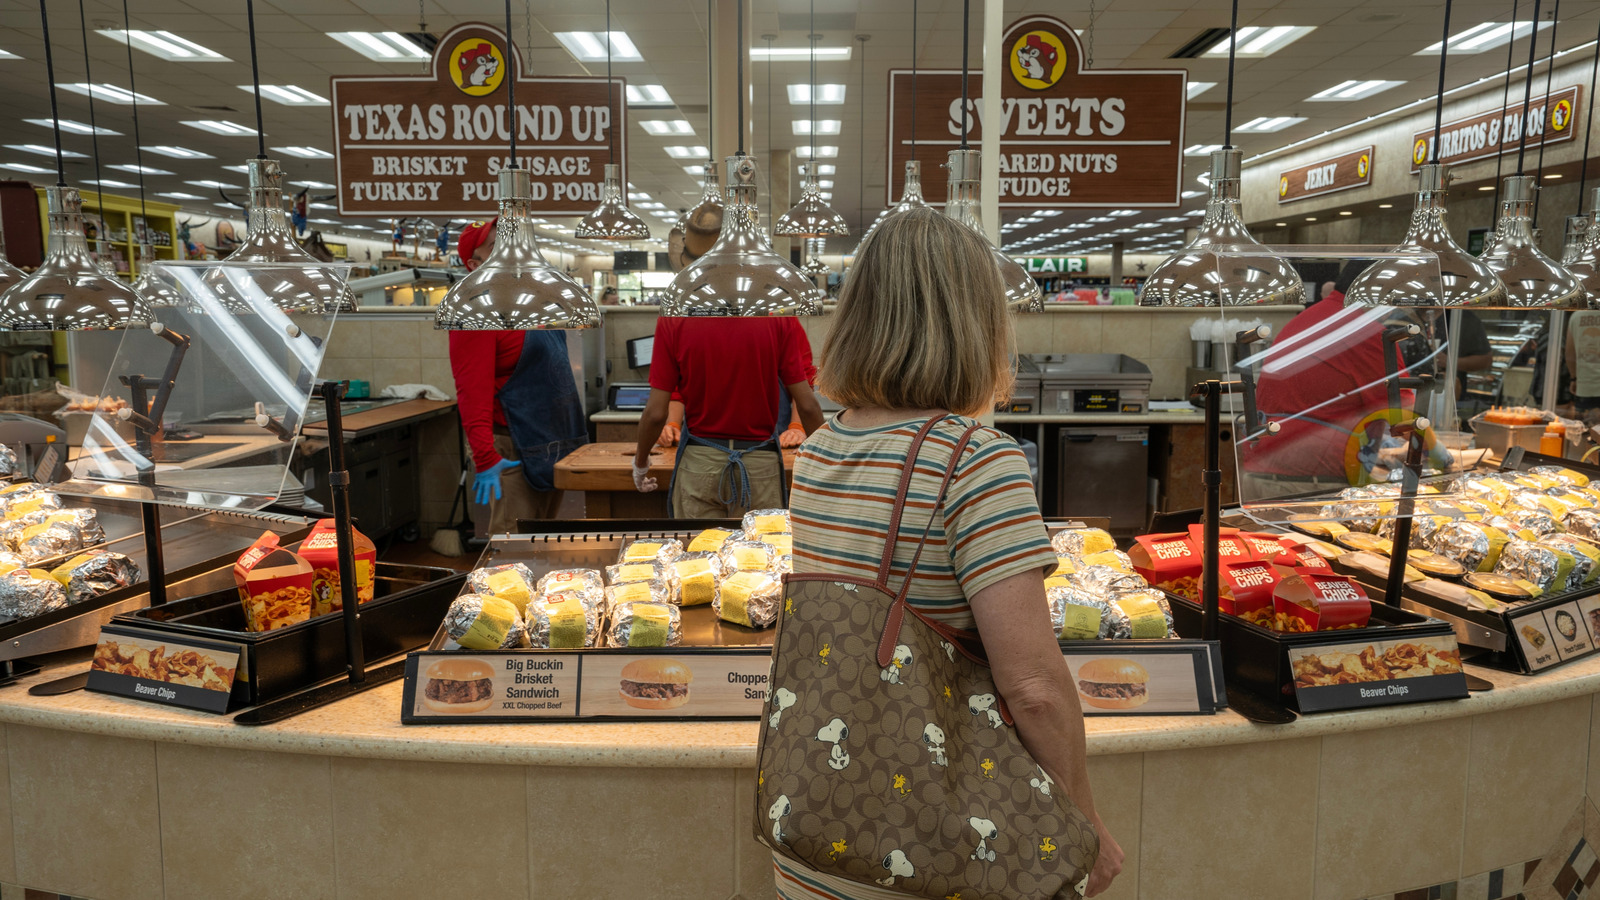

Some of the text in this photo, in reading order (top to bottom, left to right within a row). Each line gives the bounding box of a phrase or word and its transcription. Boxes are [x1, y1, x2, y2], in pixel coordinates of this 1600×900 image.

[344, 104, 611, 142] TEXAS ROUND UP
[1488, 118, 1500, 147] &
[372, 156, 468, 176] BRISKET
[1059, 154, 1117, 173] NUTS
[1304, 163, 1337, 191] JERKY
[350, 182, 442, 201] TURKEY
[999, 177, 1071, 197] FUDGE
[313, 532, 337, 540] BEAVE
[1249, 538, 1279, 546] BEAVER
[1151, 540, 1186, 550] BEAVER
[1156, 546, 1192, 559] CHIPS
[1229, 566, 1266, 578] BEAVER
[1235, 572, 1274, 588] CHIPS
[1314, 581, 1352, 590] BEAVER
[1321, 588, 1360, 601] CHIPS
[506, 659, 563, 672] Big Buckin
[515, 673, 553, 684] Brisket
[728, 672, 767, 685] Choppe
[135, 683, 176, 700] Beaver Chips
[506, 687, 559, 698] Sandwich
[745, 688, 765, 699] San
[1360, 685, 1409, 698] Beaver Chips
[517, 702, 545, 710] Chopped
[547, 702, 562, 710] Beef
